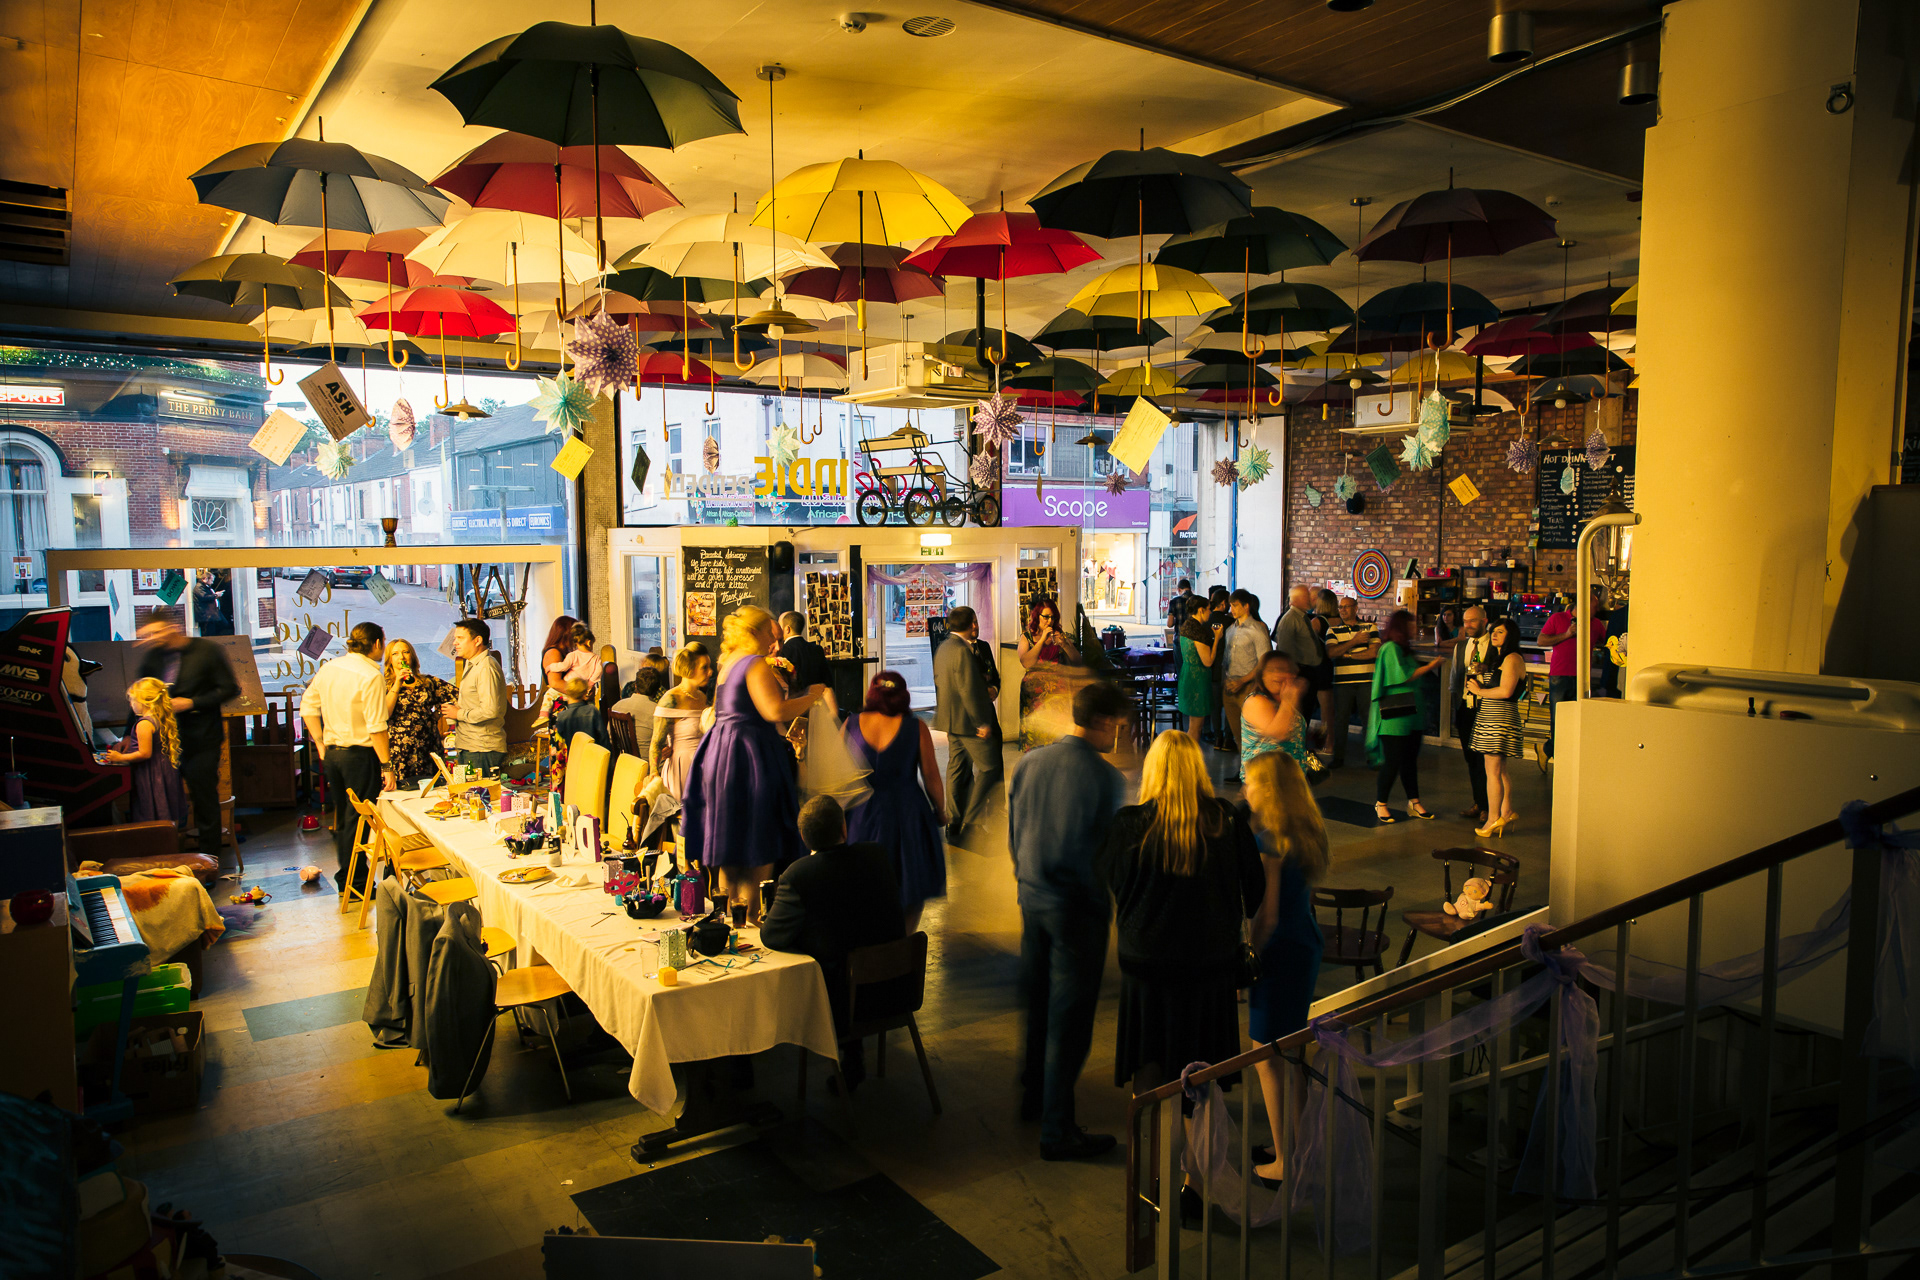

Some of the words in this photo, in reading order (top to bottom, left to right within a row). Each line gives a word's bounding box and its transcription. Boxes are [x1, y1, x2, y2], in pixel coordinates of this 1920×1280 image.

[0, 392, 60, 403] SPORTS
[325, 381, 356, 416] ASH
[167, 401, 190, 413] THE
[192, 404, 226, 418] PENNY
[229, 409, 255, 421] BANK
[1044, 495, 1108, 521] Scope
[1179, 531, 1197, 539] FACTOR
[167, 577, 181, 598] DOWN
[17, 645, 42, 656] SNK
[0, 663, 40, 681] MVS
